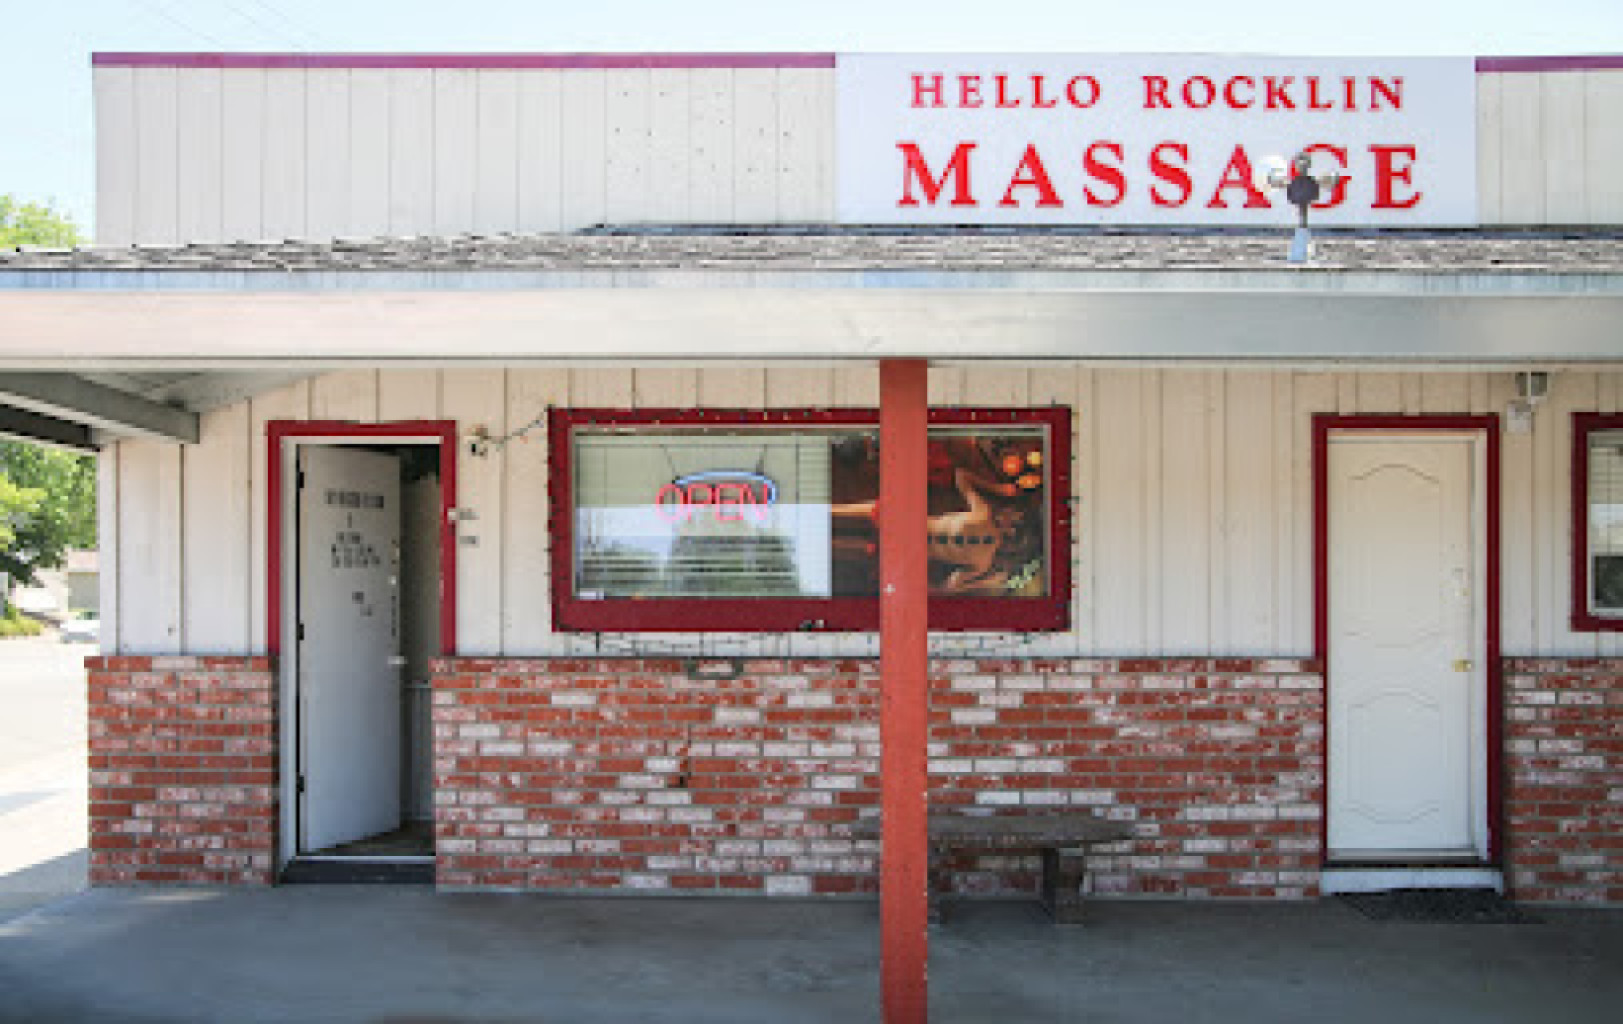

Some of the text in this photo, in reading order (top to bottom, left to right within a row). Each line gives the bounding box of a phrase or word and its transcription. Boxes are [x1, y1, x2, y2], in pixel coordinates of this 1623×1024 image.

[910, 74, 1404, 112] HELLO ROCKLIN
[895, 140, 1423, 210] MASSAGE
[655, 482, 769, 523] OPEN
